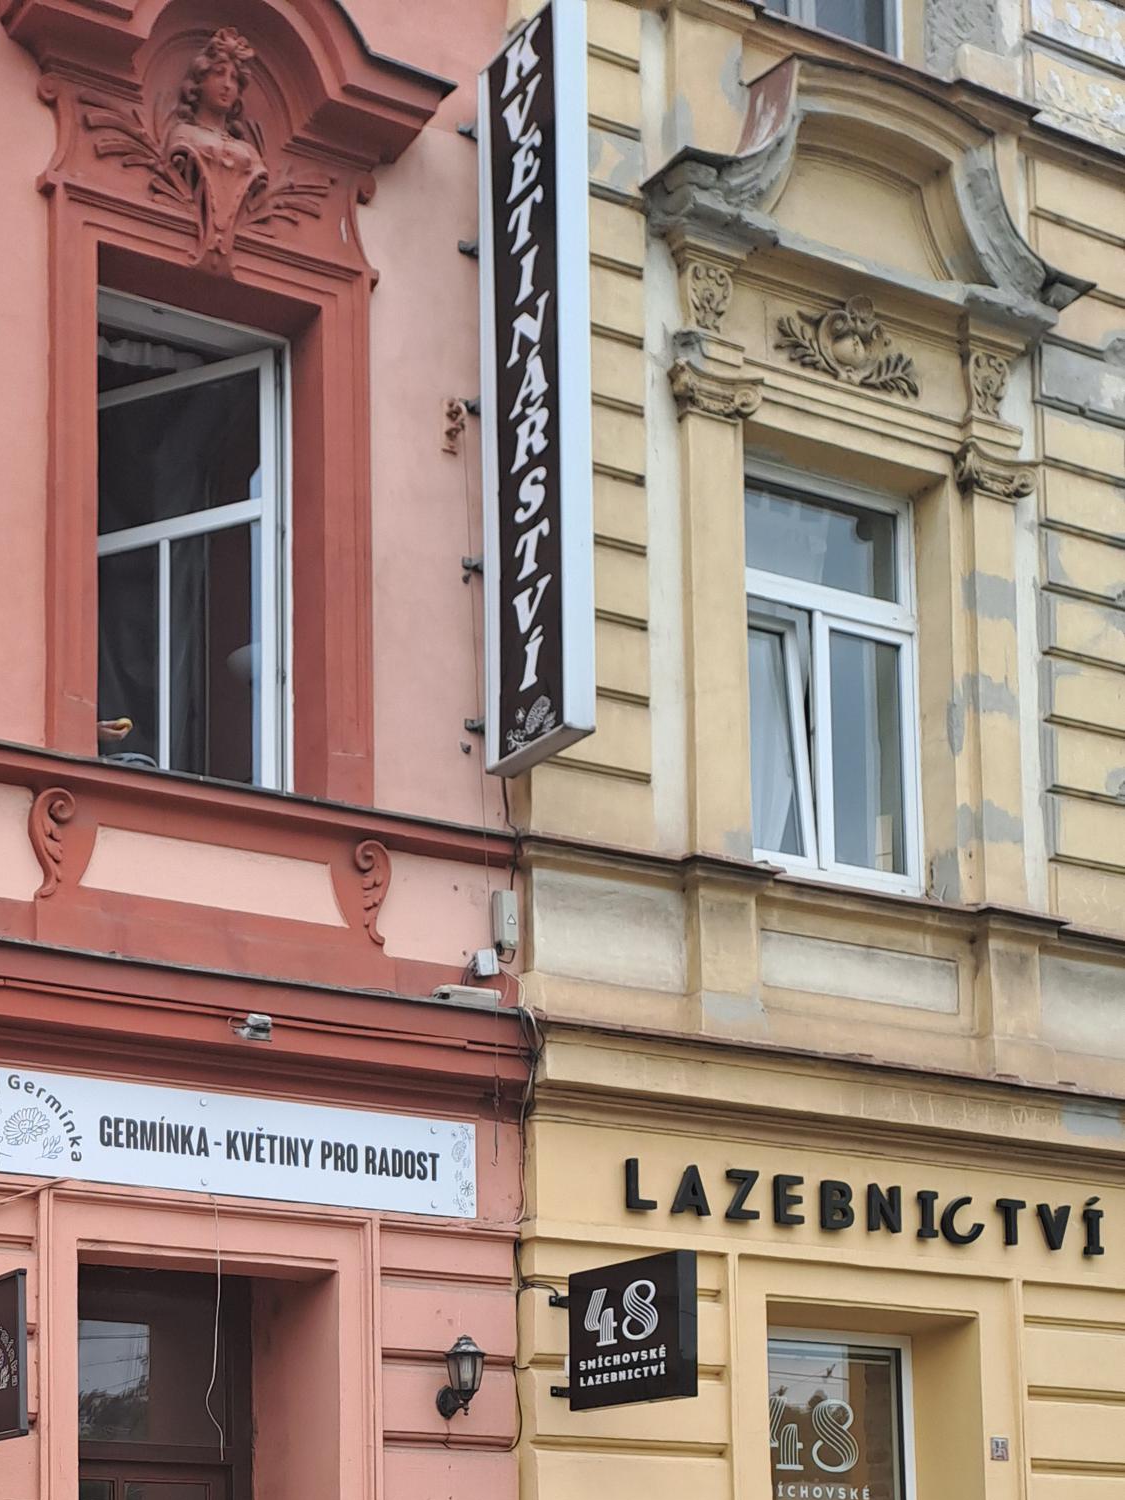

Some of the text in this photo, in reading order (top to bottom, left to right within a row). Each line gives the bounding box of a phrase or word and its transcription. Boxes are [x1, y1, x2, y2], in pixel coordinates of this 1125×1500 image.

[500, 16, 553, 692] KVĚTINÁŘSTVÍ
[7, 1074, 83, 1163] Germínka
[98, 1115, 210, 1158] GERMÍNKA
[225, 1127, 314, 1169] KVĚTINY
[320, 1141, 359, 1174] PRO
[364, 1145, 440, 1182] RADOST
[623, 1156, 1106, 1257] LAZEBNICTVÍ
[584, 1279, 659, 1347] 48
[578, 1344, 667, 1371] SMÍCHOVSKÉ
[579, 1361, 666, 1387] LAZEBNICTVÍ
[776, 1480, 871, 1500] ÍCHOVSKÉ
